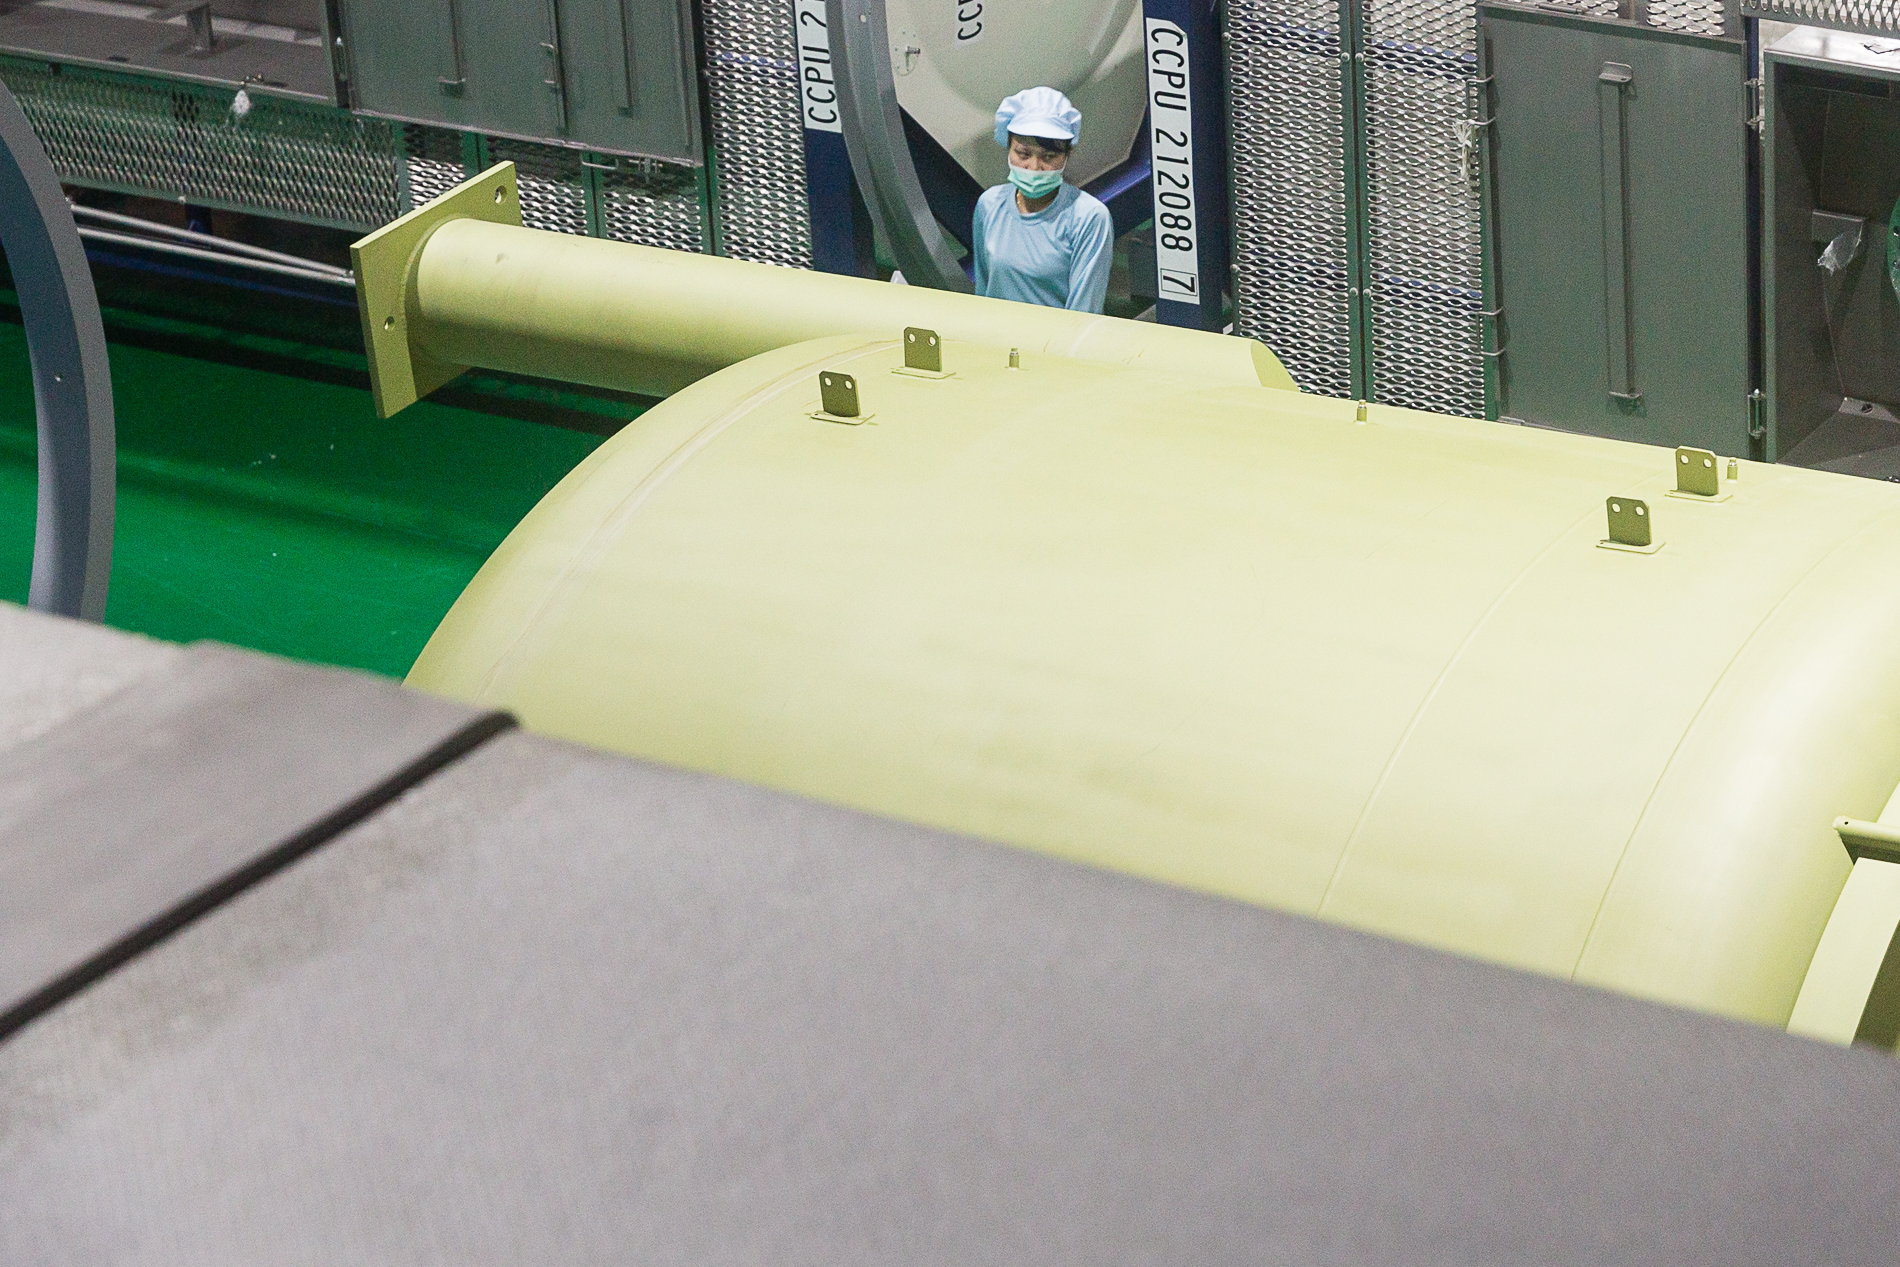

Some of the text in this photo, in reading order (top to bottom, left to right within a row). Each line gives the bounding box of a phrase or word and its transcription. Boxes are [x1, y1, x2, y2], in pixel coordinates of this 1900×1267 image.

[802, 45, 838, 124] CCPU
[1150, 27, 1196, 294] CCPU 212088 7
